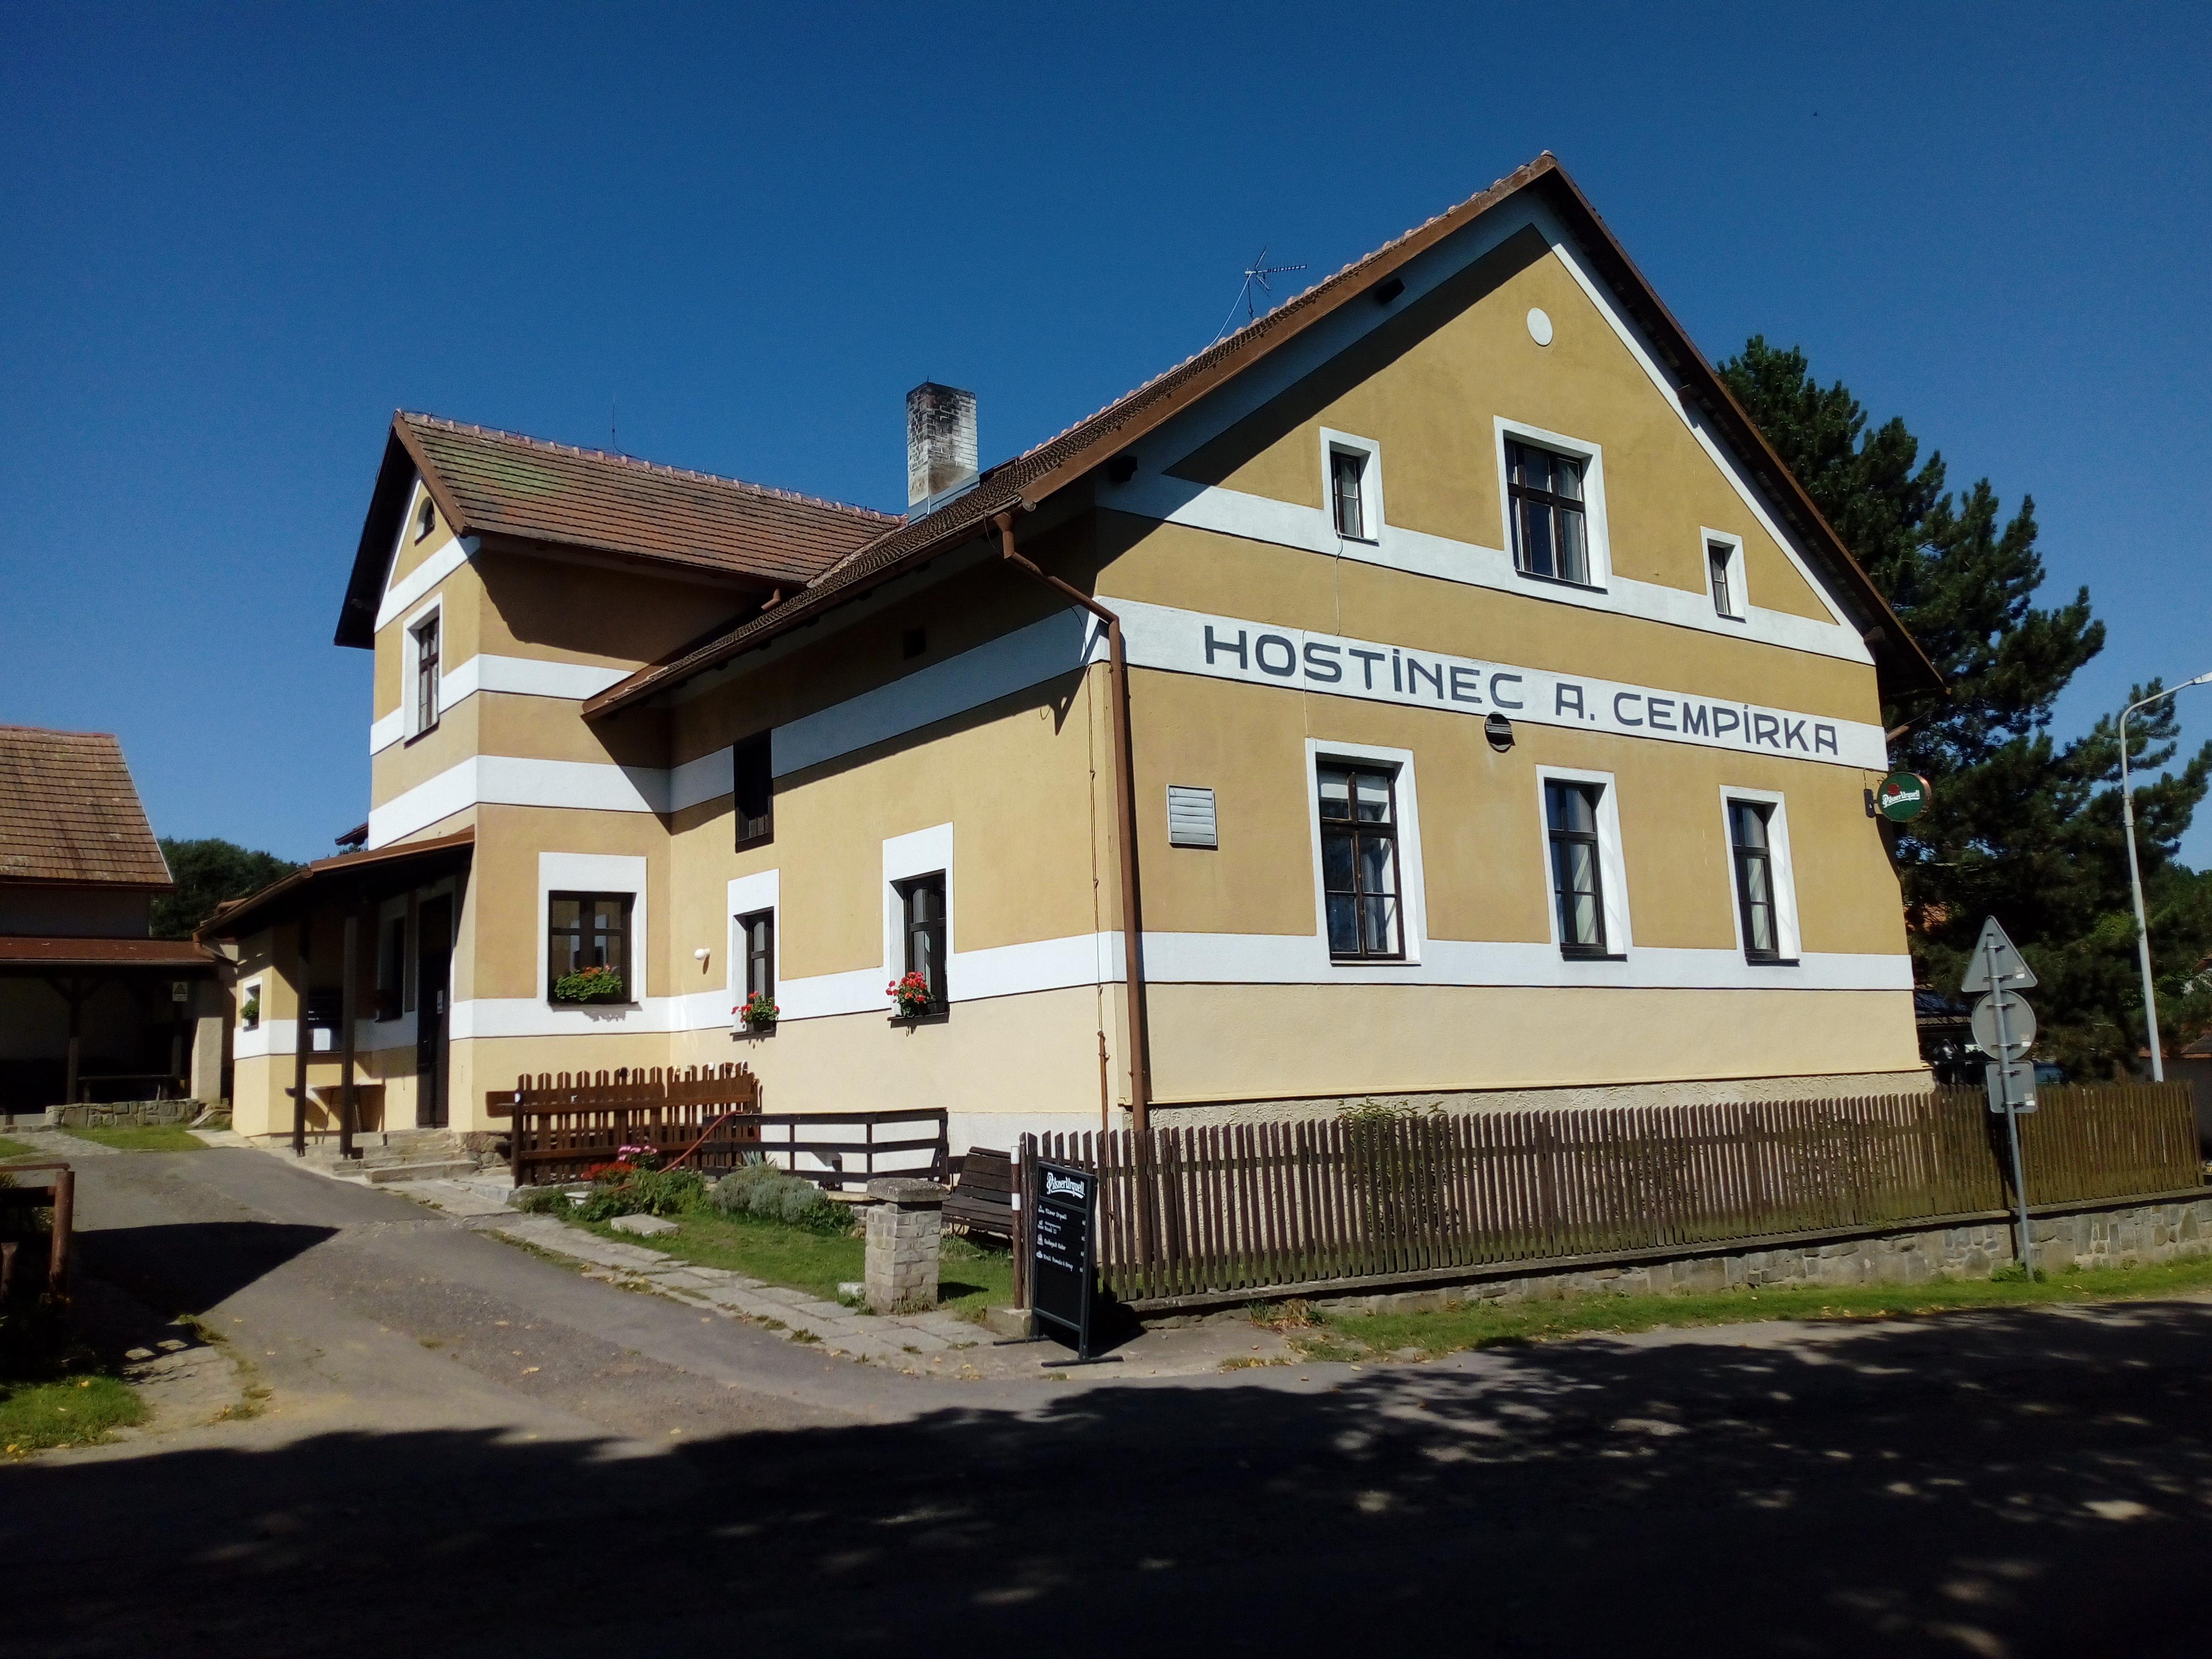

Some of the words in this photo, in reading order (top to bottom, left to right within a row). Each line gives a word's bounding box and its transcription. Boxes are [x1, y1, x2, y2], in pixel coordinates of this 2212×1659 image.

[1555, 682, 1595, 721] A.
[1046, 1172, 1066, 1194] Pilsner
[1065, 1177, 1085, 1197] Urquell
